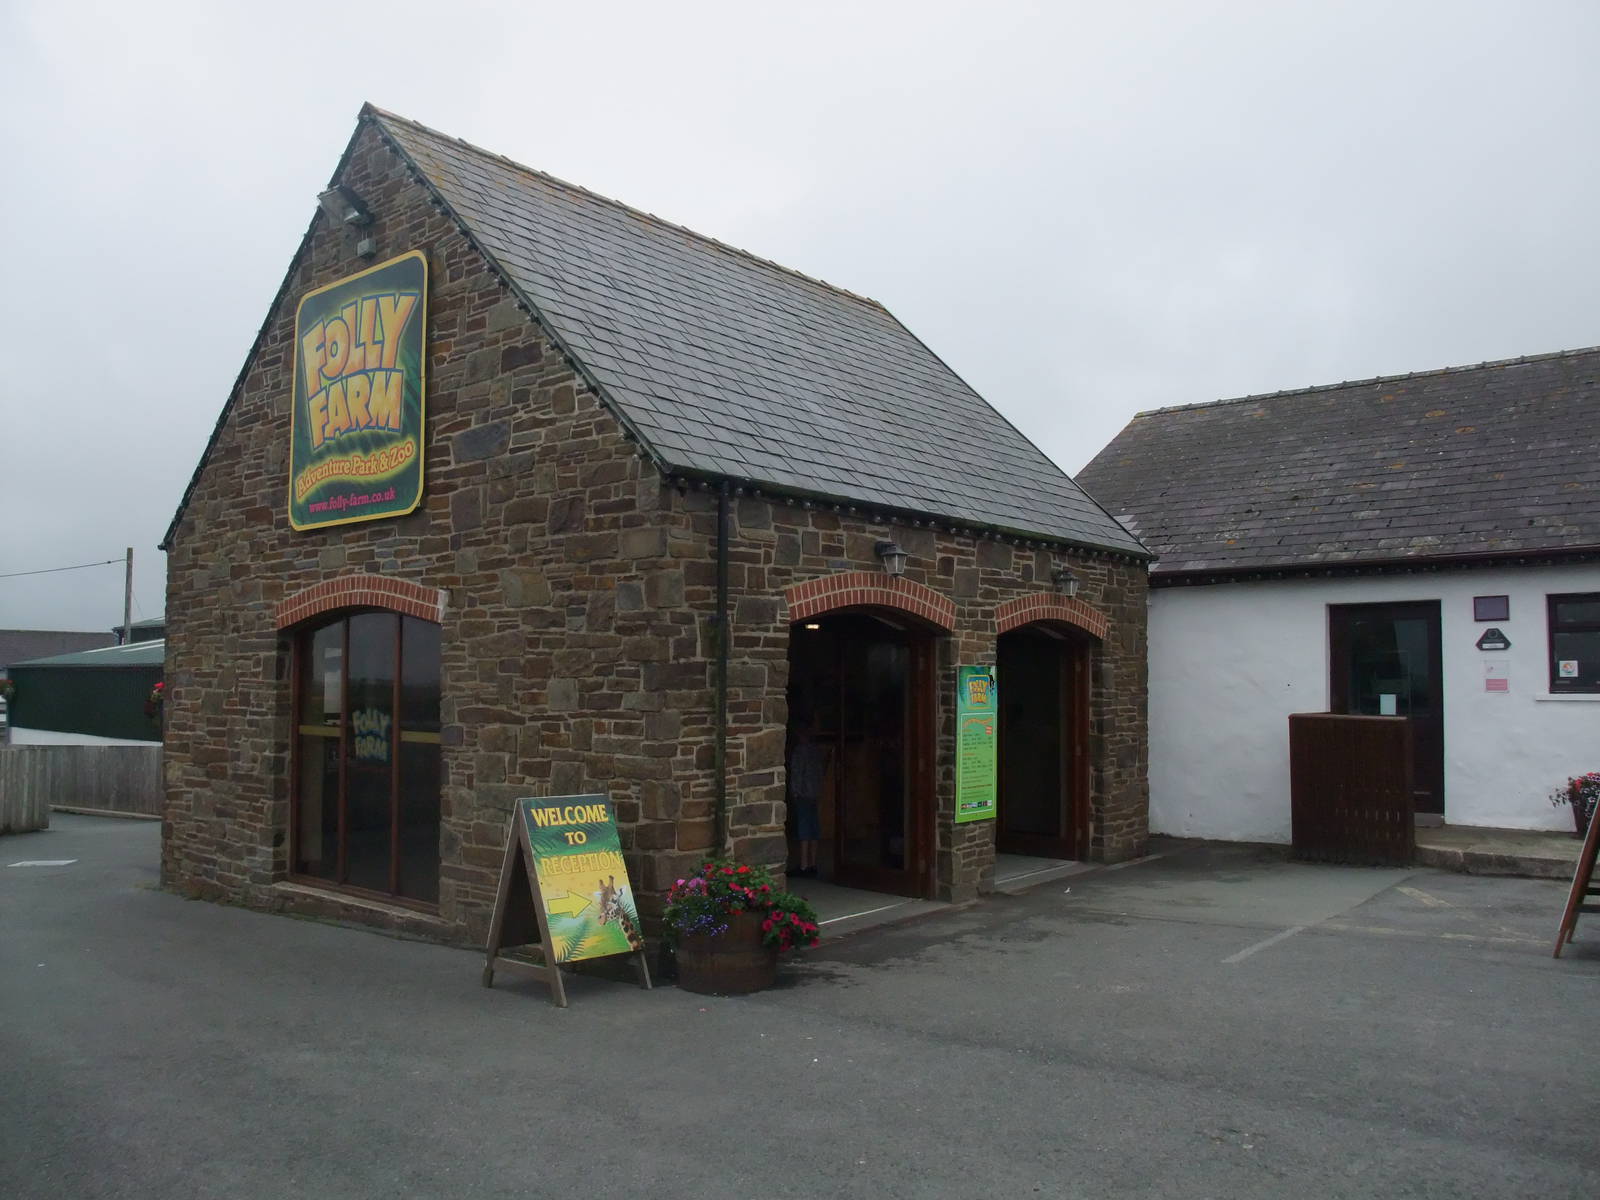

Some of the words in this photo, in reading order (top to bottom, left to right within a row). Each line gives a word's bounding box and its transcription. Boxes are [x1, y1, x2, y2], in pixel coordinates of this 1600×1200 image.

[302, 292, 419, 396] FOLLY
[308, 370, 404, 451] FARM
[296, 457, 351, 498] Adventure
[351, 455, 379, 476] Park
[379, 451, 390, 473] &
[389, 441, 414, 469] Zoo
[309, 487, 396, 512] www.folly-farm.co.uk
[531, 804, 609, 827] WELCOME
[564, 831, 588, 845] TO
[541, 851, 622, 875] RECEPTION
